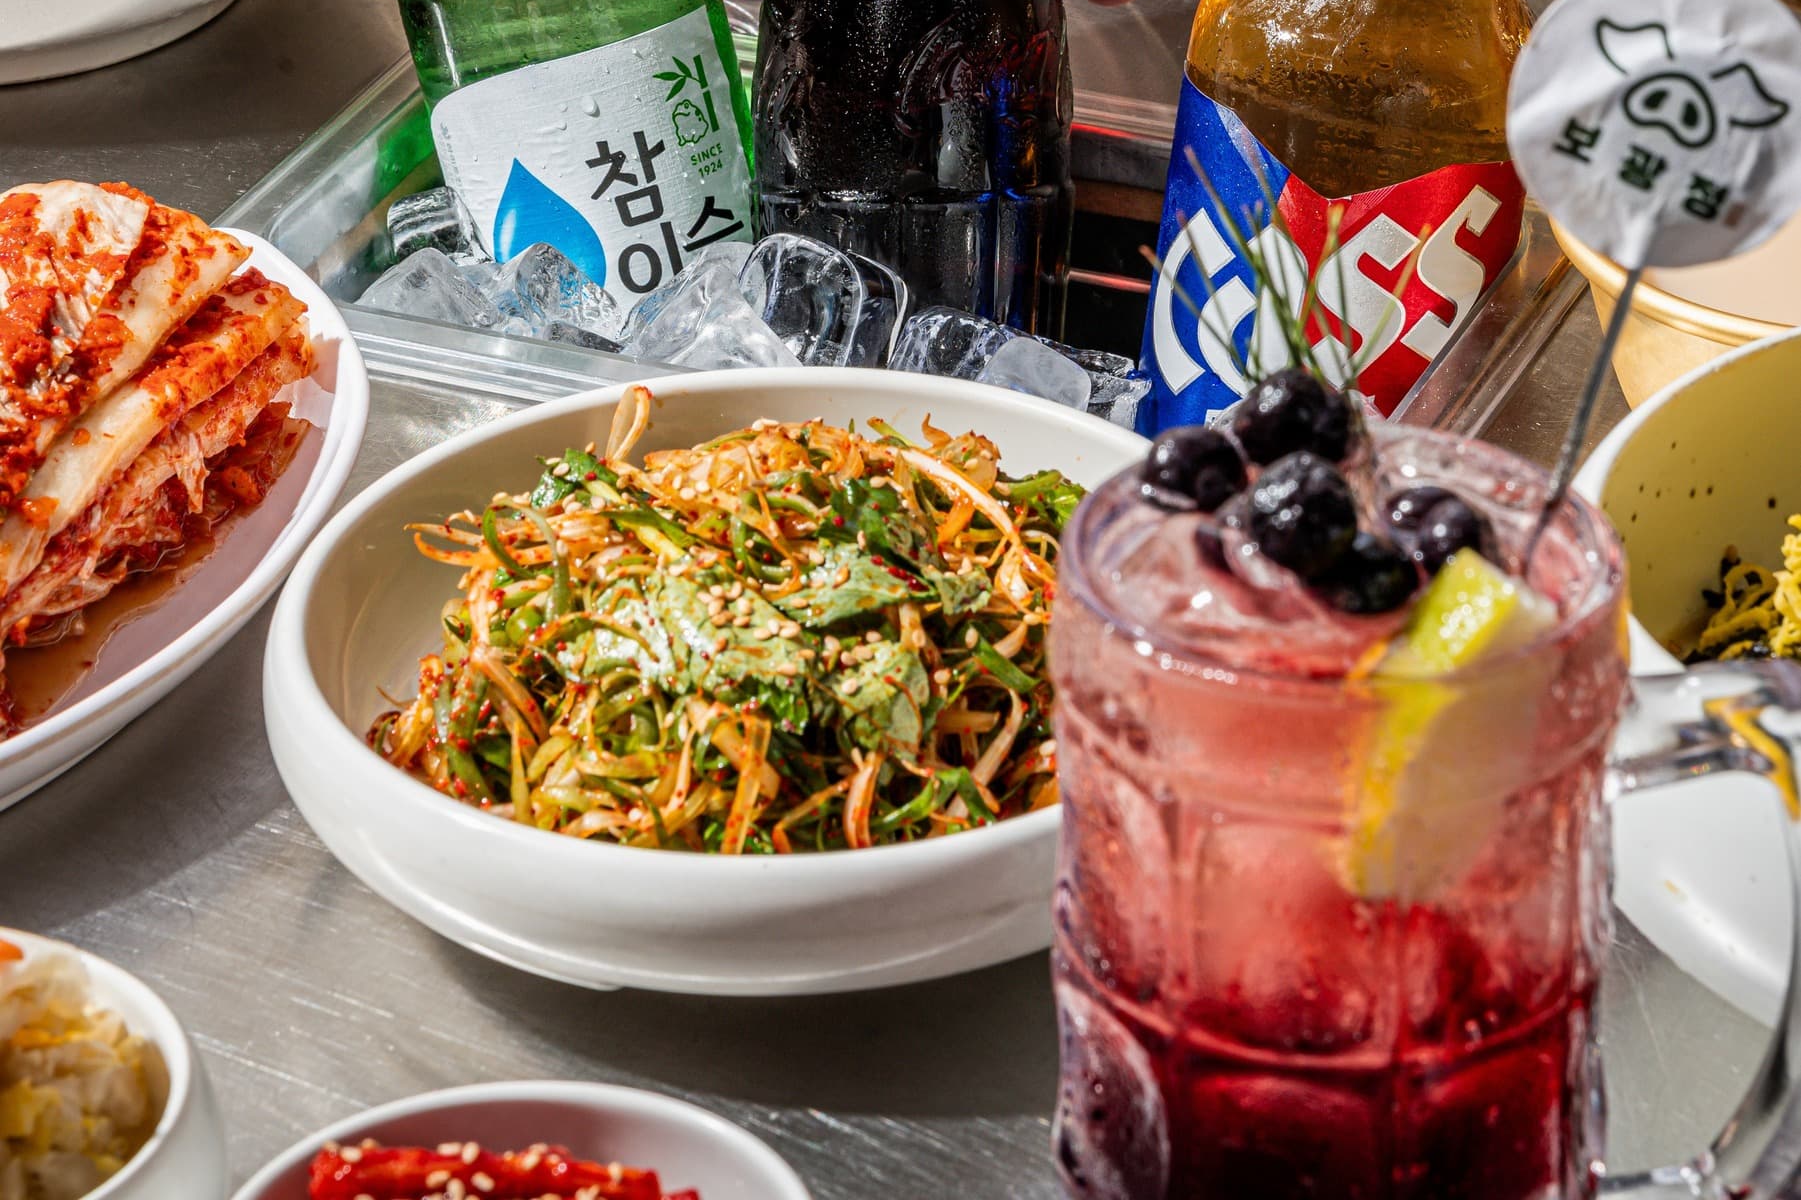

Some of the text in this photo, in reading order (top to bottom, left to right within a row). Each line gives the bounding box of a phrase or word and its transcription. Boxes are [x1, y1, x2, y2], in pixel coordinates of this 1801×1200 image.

[690, 142, 723, 166] SINCE
[585, 130, 666, 227] 참
[698, 158, 723, 178] 1924
